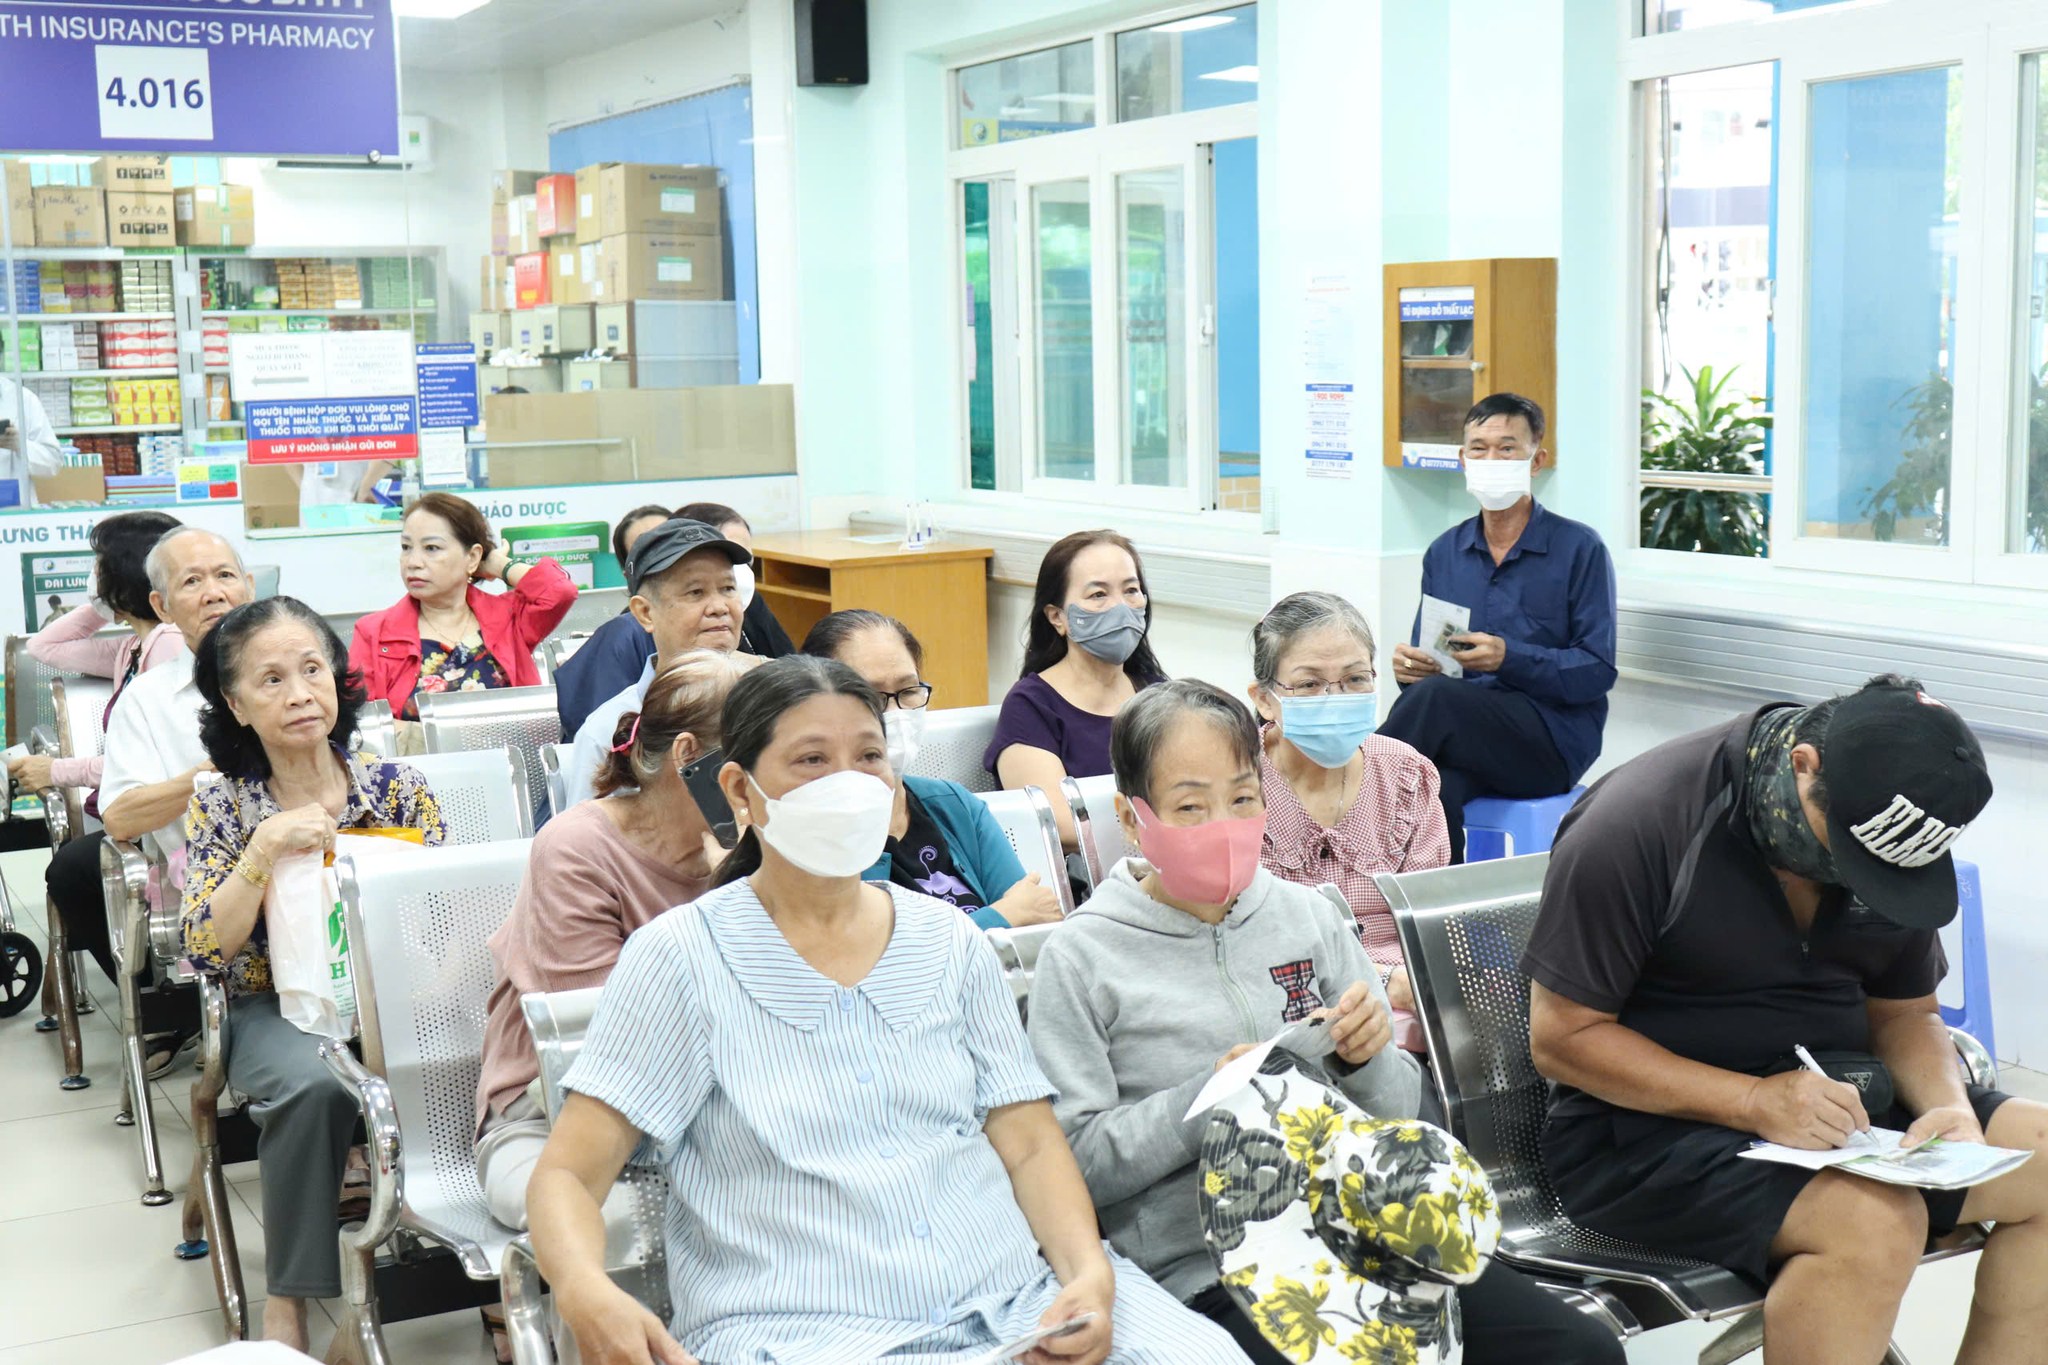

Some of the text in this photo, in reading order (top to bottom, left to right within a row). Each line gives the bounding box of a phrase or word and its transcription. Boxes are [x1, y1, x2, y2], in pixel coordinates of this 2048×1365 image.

[40, 15, 224, 45] INSURANCE'S
[230, 23, 375, 50] PHARMACY
[105, 77, 205, 109] 4.016
[348, 404, 363, 414] VUI
[394, 412, 410, 422] TRA
[324, 425, 339, 433] KHI
[479, 500, 567, 519] HẢO DƯỢC
[0, 526, 50, 544] ƯNG
[66, 576, 88, 588] LƯN
